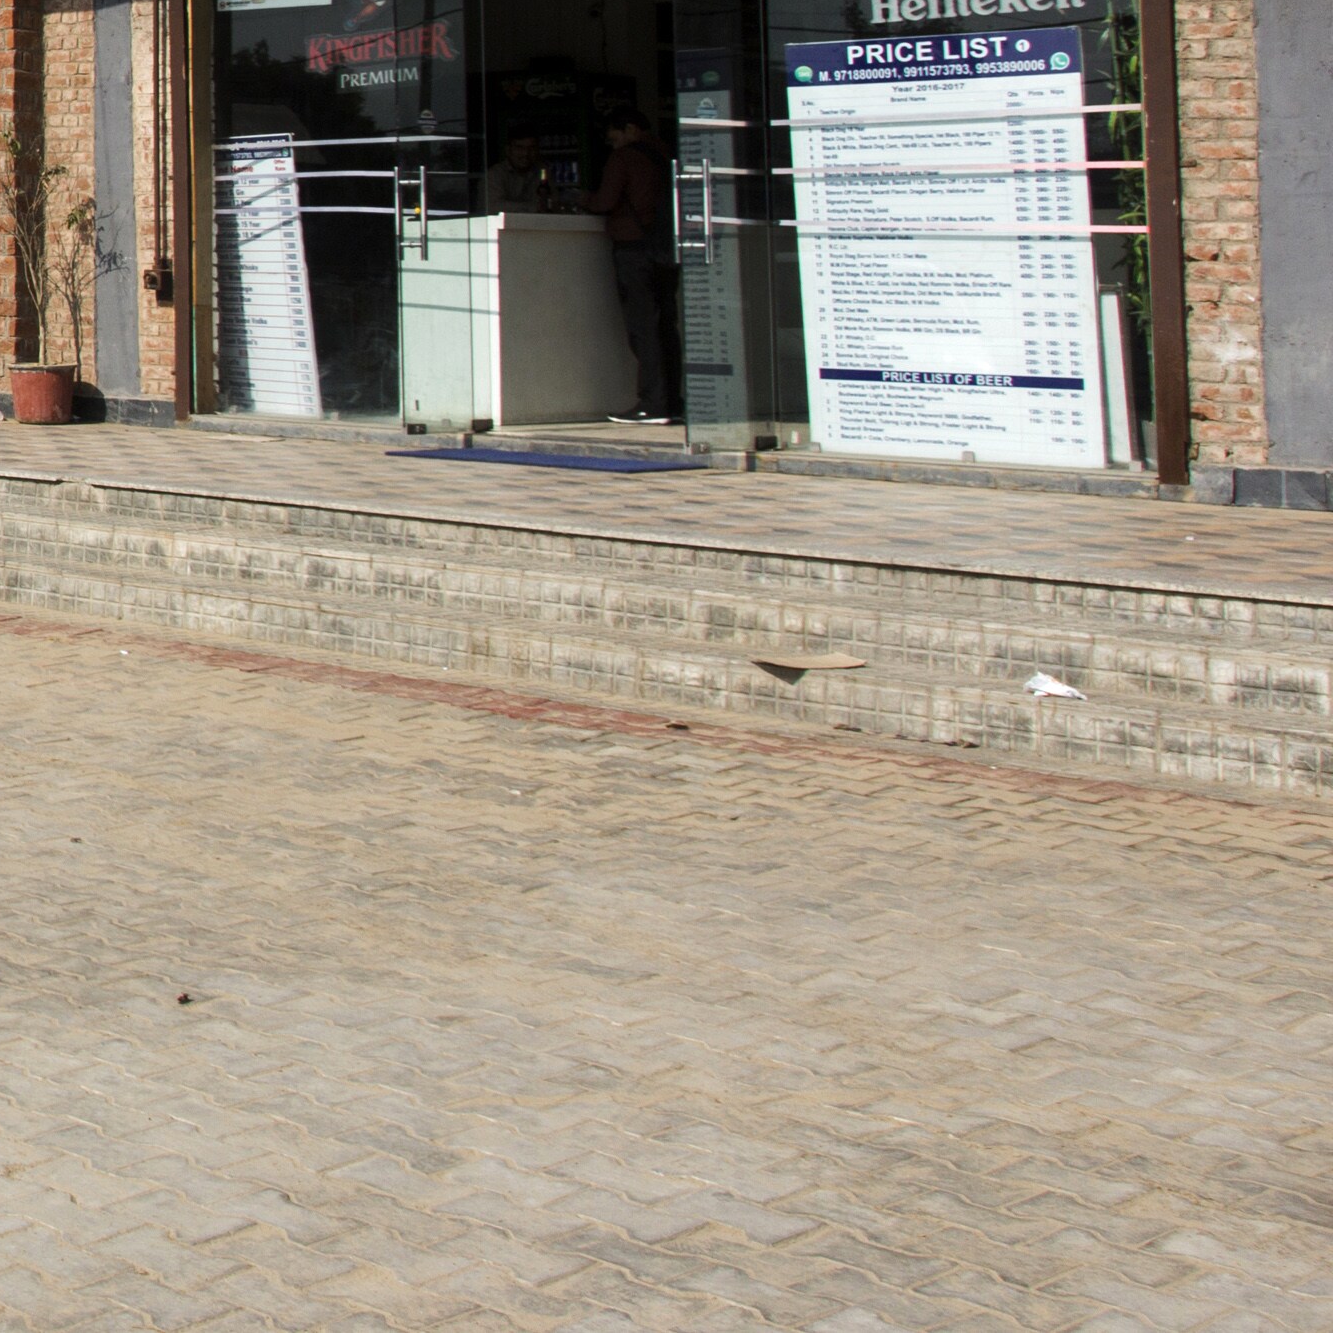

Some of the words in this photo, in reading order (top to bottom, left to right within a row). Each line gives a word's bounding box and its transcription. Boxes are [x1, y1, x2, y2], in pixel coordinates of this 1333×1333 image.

[307, 20, 454, 72] KINGFISHER
[846, 40, 934, 65] PRICE
[942, 36, 1008, 60] LIST
[340, 67, 419, 88] PREMIUM
[881, 371, 921, 382] PRICE
[922, 373, 952, 383] LIST
[953, 374, 973, 384] OF
[974, 375, 1013, 386] BEER
